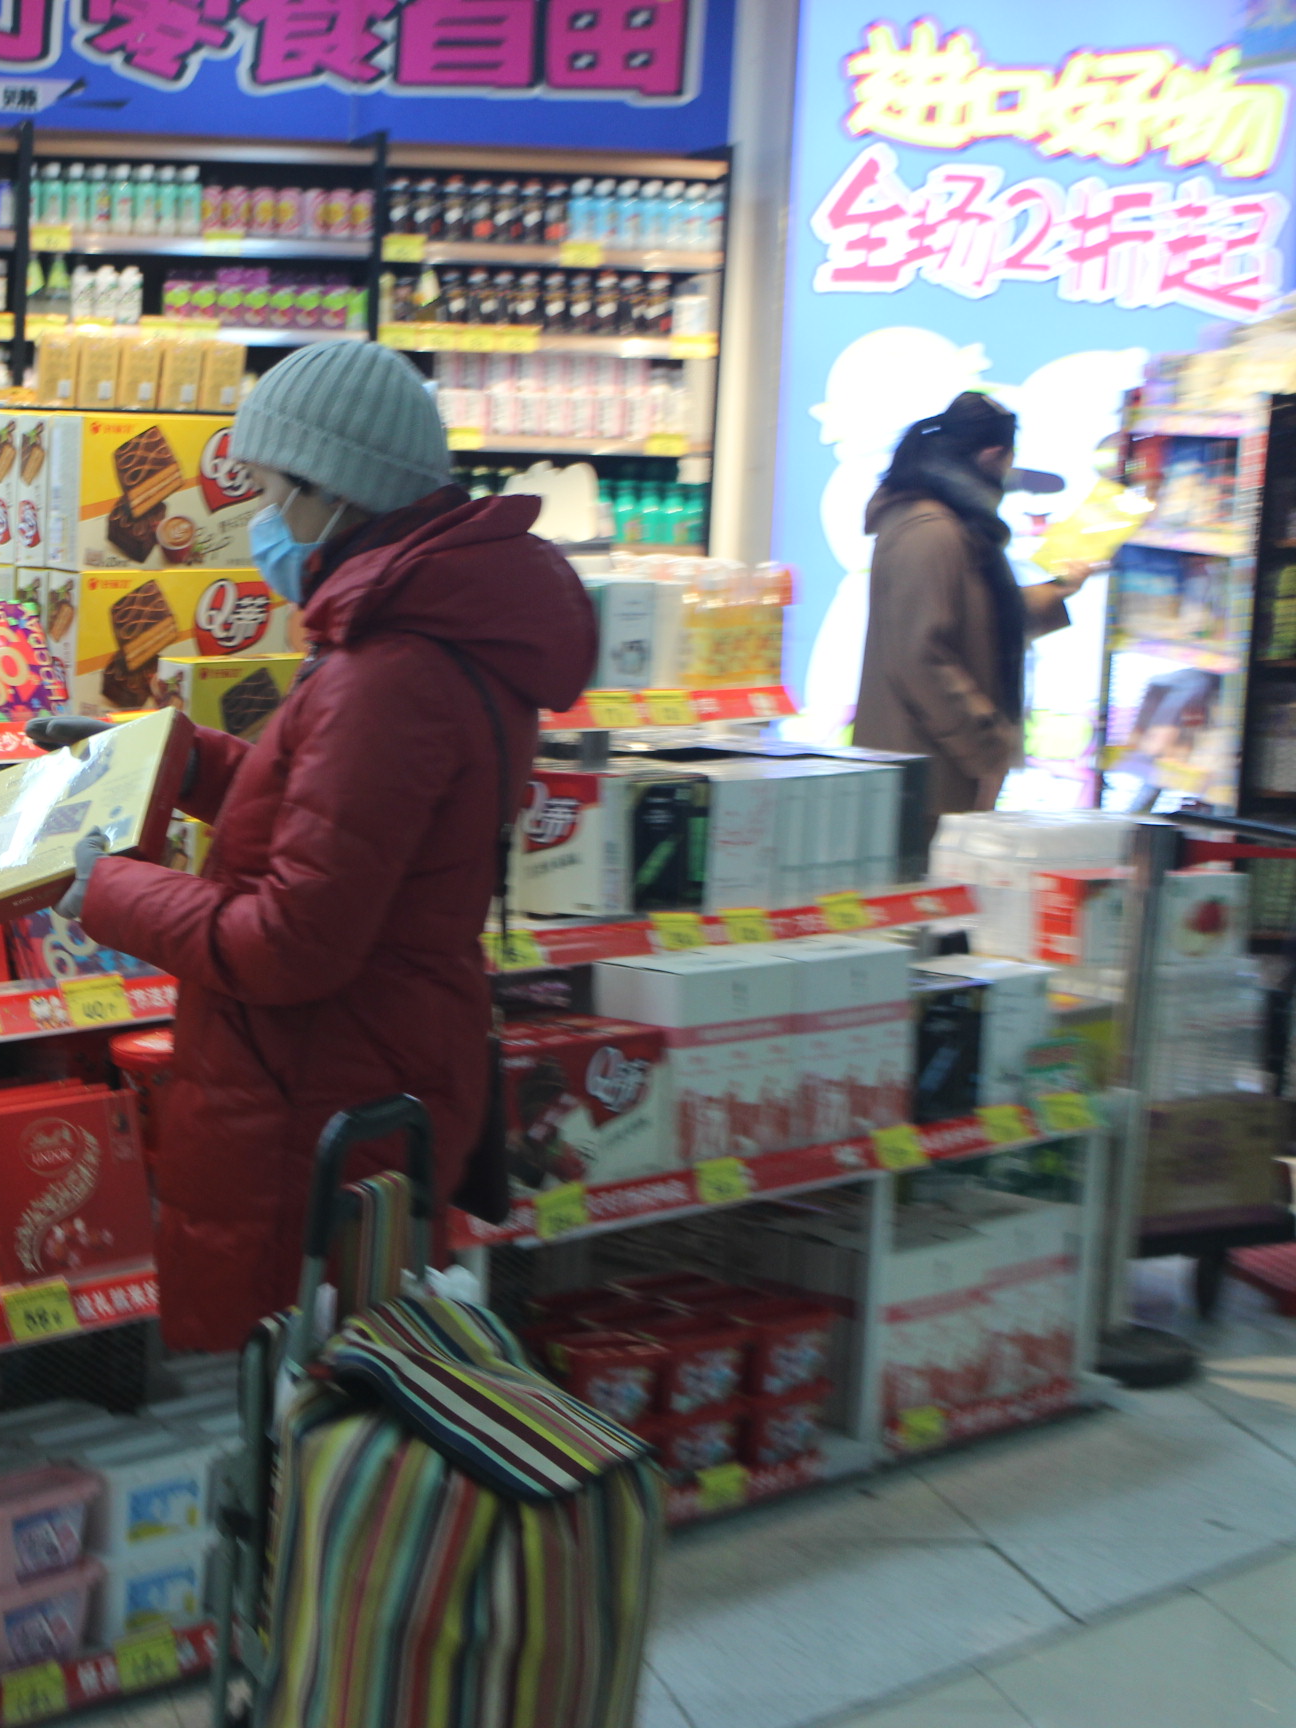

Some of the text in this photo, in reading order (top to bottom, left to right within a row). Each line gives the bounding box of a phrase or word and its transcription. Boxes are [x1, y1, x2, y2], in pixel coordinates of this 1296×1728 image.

[847, 20, 1287, 178] 进口好物
[816, 148, 1286, 317] 全场2折起
